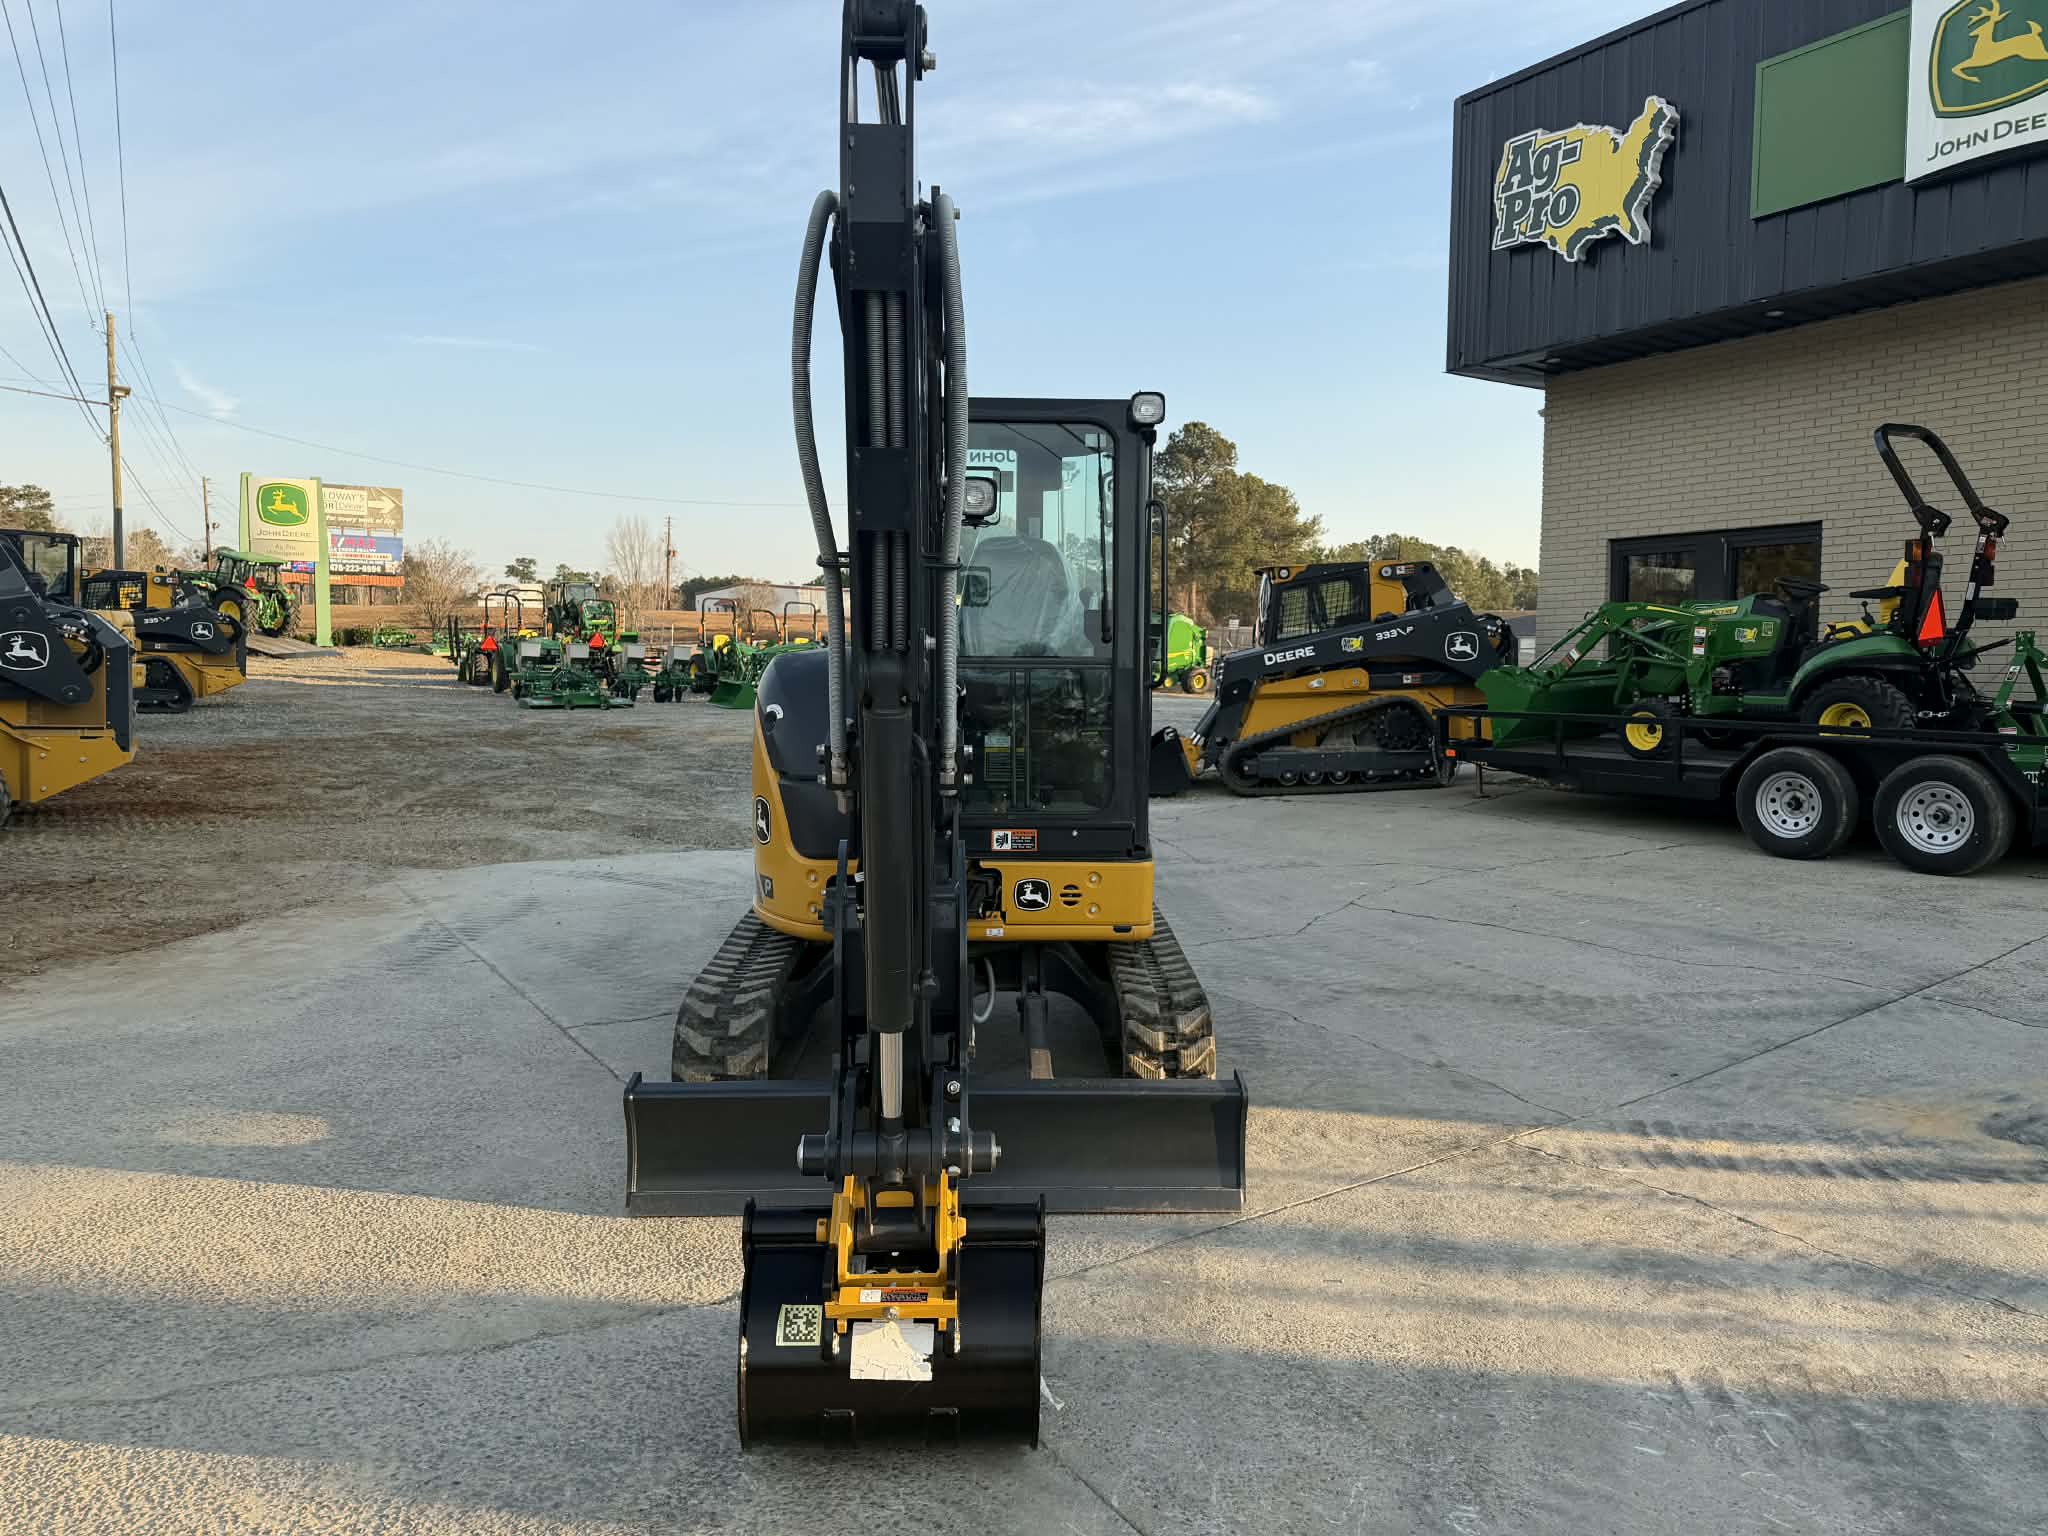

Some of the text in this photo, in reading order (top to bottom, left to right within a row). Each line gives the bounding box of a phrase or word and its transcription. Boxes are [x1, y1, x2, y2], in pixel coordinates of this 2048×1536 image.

[1501, 136, 1582, 197] Ag-
[1927, 129, 1988, 161] JOHN
[1496, 185, 1580, 245] Pro
[1264, 646, 1315, 665] DEERE
